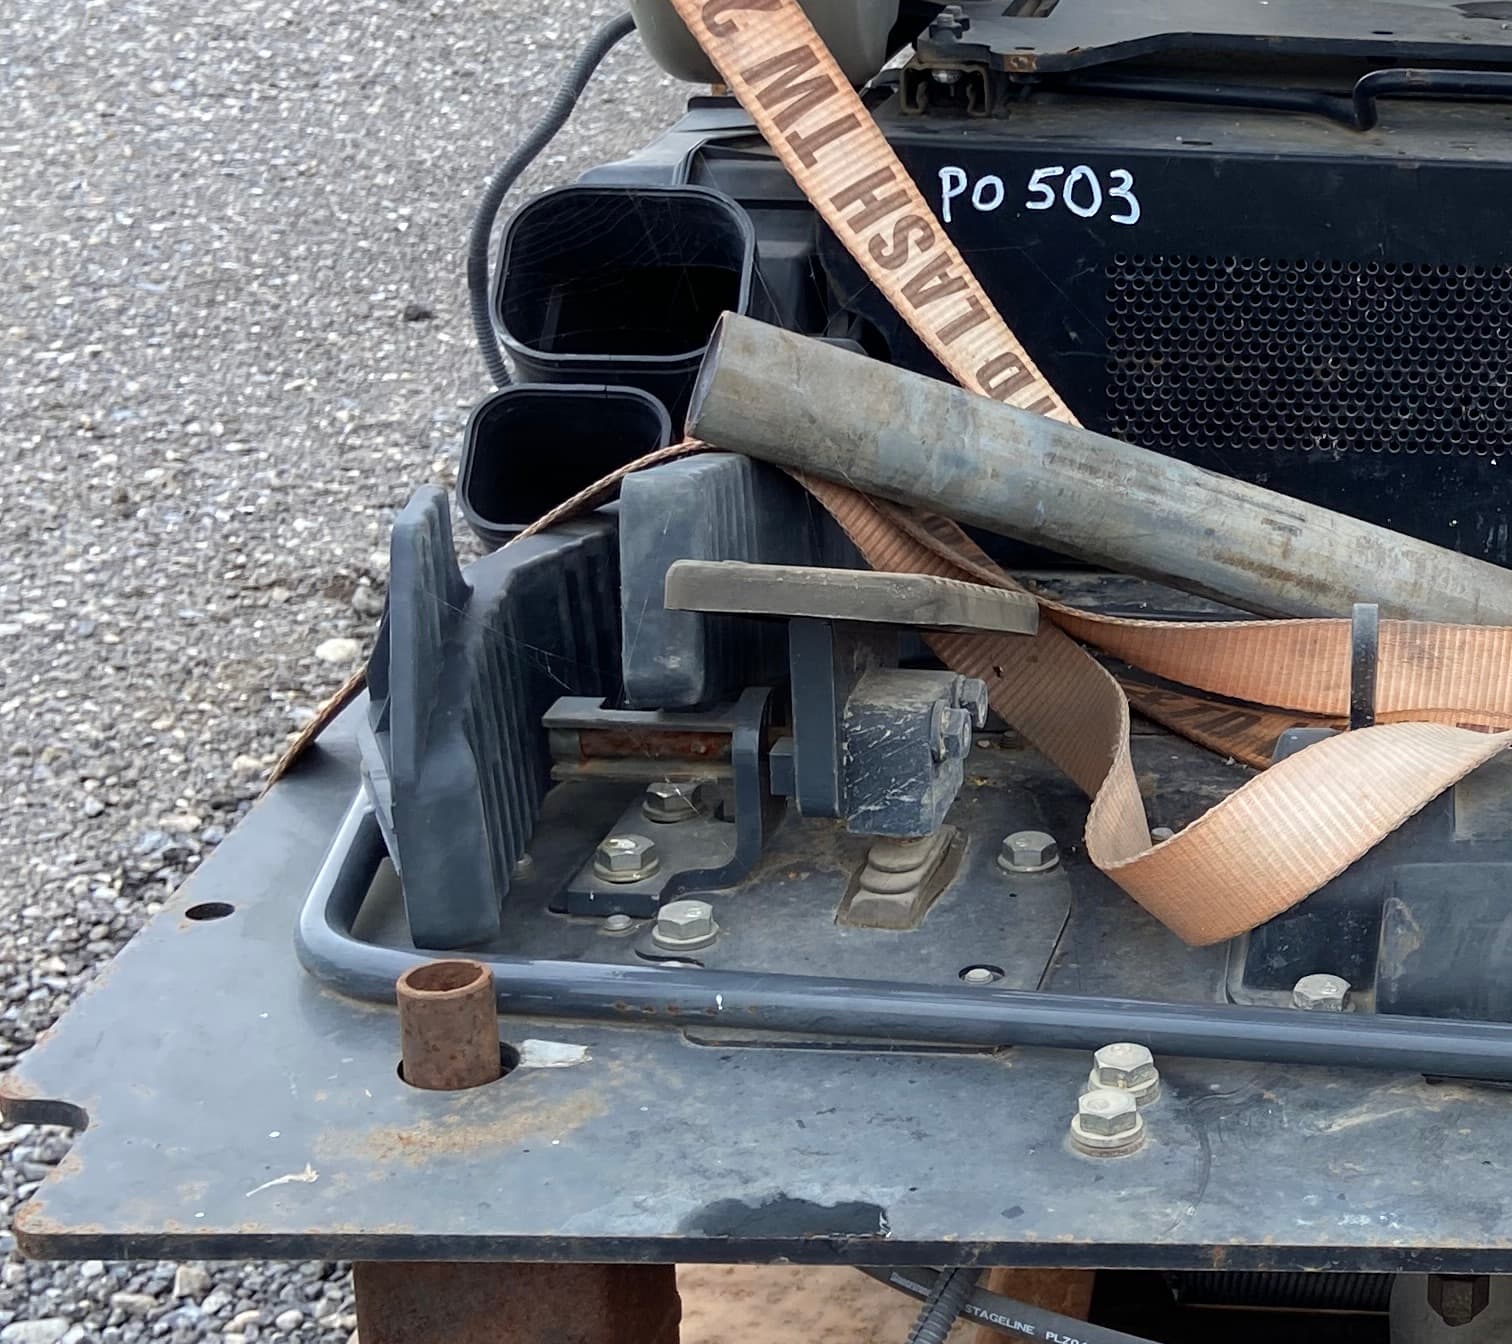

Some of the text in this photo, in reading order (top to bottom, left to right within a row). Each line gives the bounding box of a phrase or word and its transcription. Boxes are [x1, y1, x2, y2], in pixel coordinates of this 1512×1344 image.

[739, 44, 862, 169] TW
[830, 166, 990, 346] LASH
[938, 164, 1141, 225] PO 503
